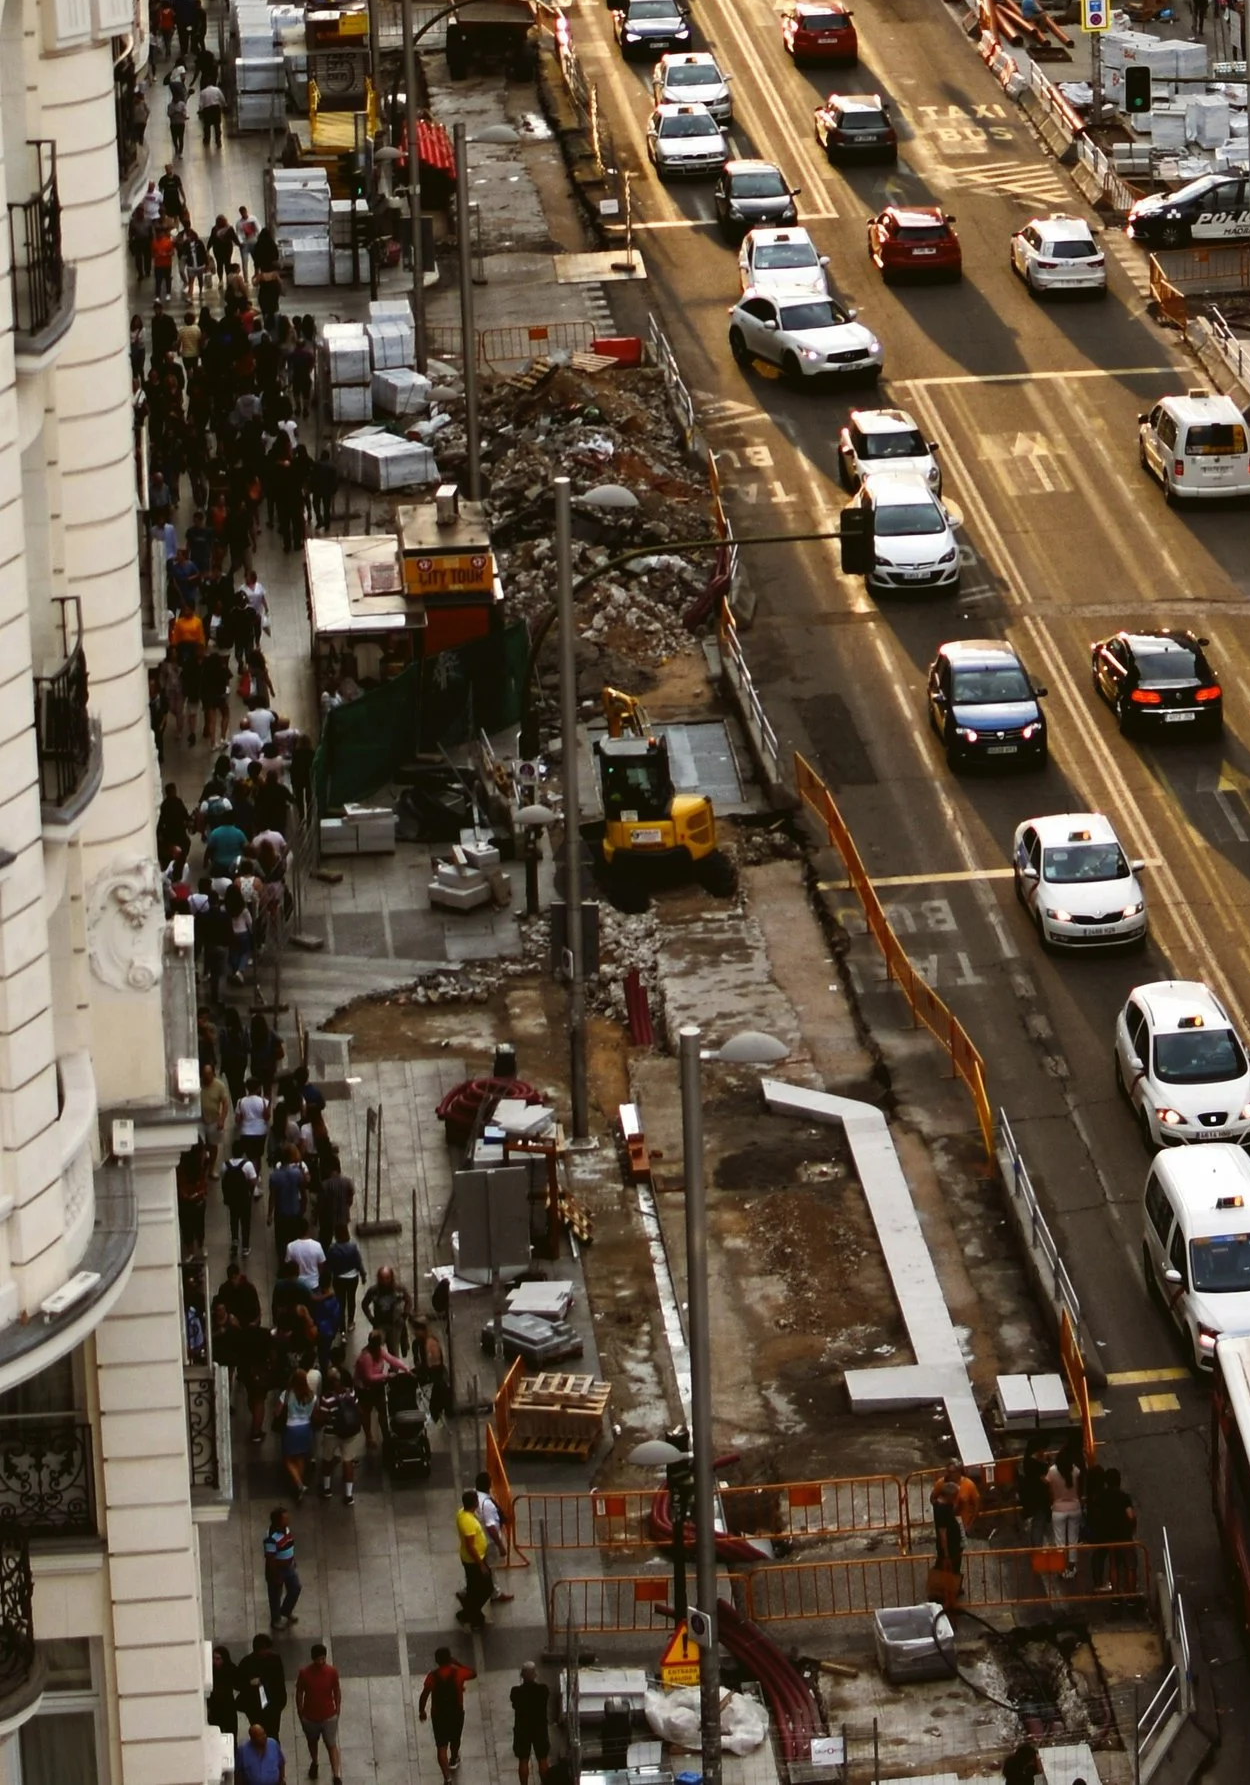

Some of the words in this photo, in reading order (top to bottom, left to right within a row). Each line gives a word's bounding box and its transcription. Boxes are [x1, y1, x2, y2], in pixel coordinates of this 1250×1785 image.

[917, 104, 1007, 120] TAXI
[937, 127, 1013, 141] BUS
[419, 569, 446, 585] CITY
[451, 568, 484, 584] TOUR
